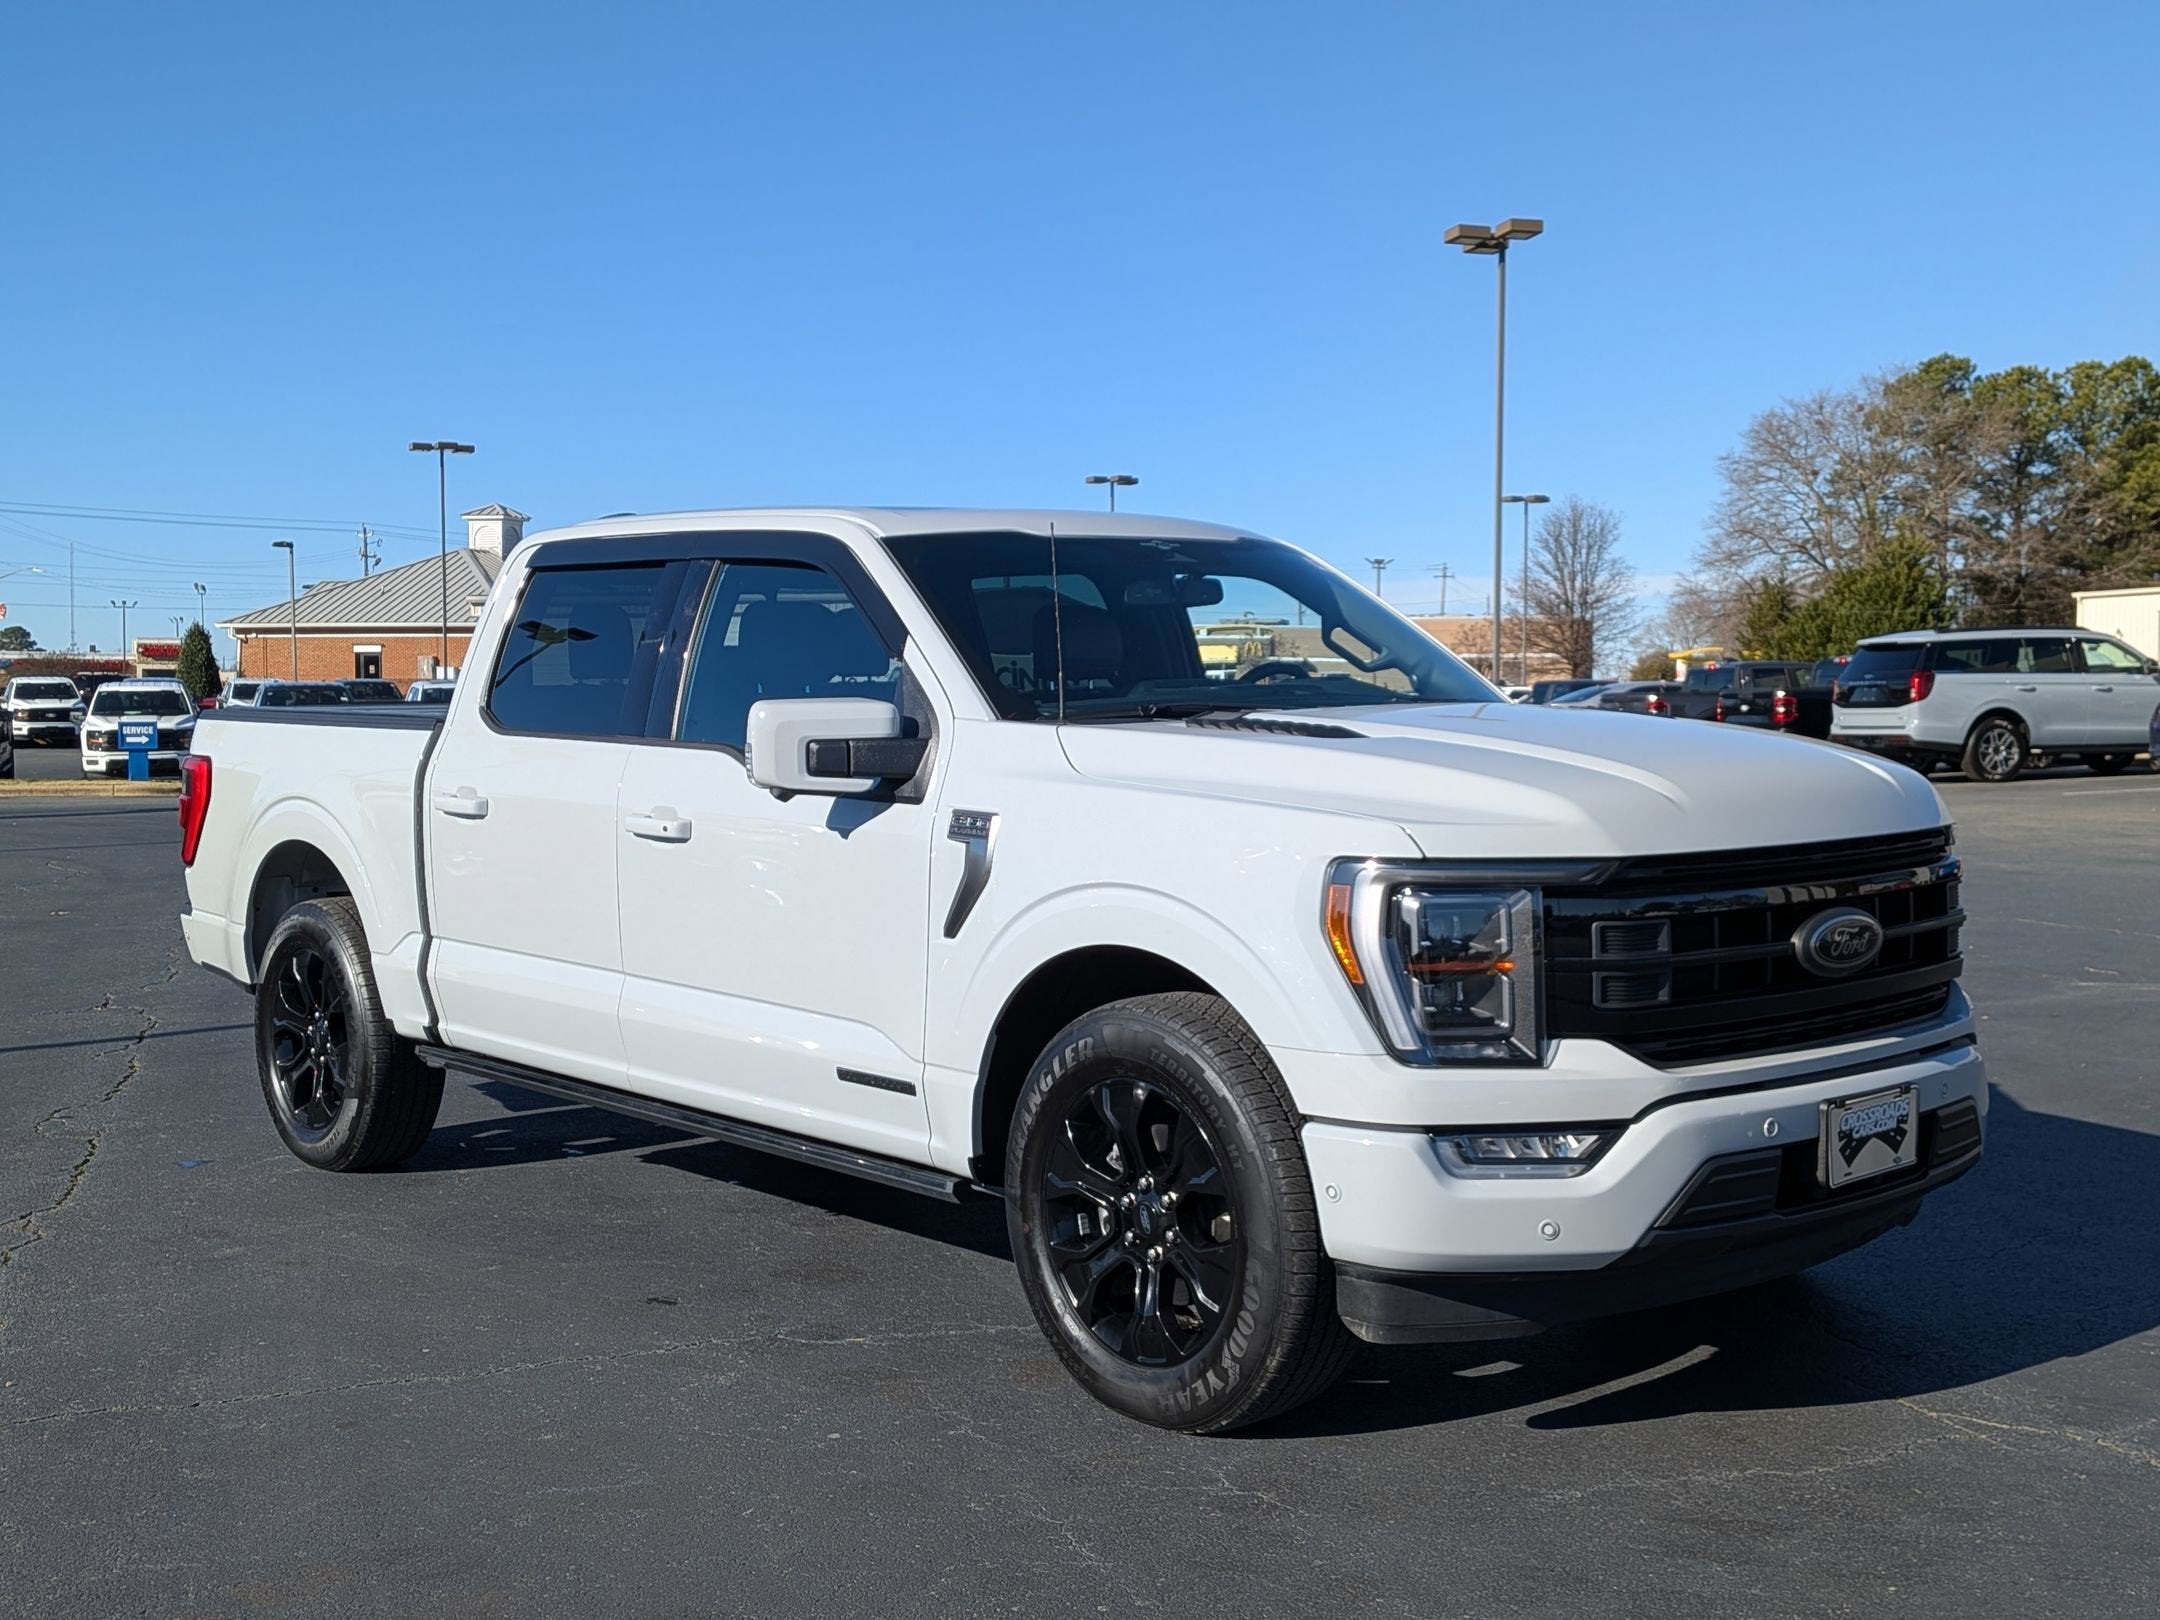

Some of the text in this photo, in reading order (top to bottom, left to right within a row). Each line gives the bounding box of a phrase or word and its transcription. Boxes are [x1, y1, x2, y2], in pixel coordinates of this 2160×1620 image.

[122, 725, 154, 735] SERVICE
[1831, 927, 1870, 957] Ford
[1007, 1036, 1095, 1188] WRANGLER
[1150, 1048, 1245, 1171] TERRITORY HT
[1839, 1097, 1910, 1131] CROSSROADS
[1852, 1116, 1898, 1138] CARS.COM
[1157, 1257, 1263, 1416] GOODYEAR
